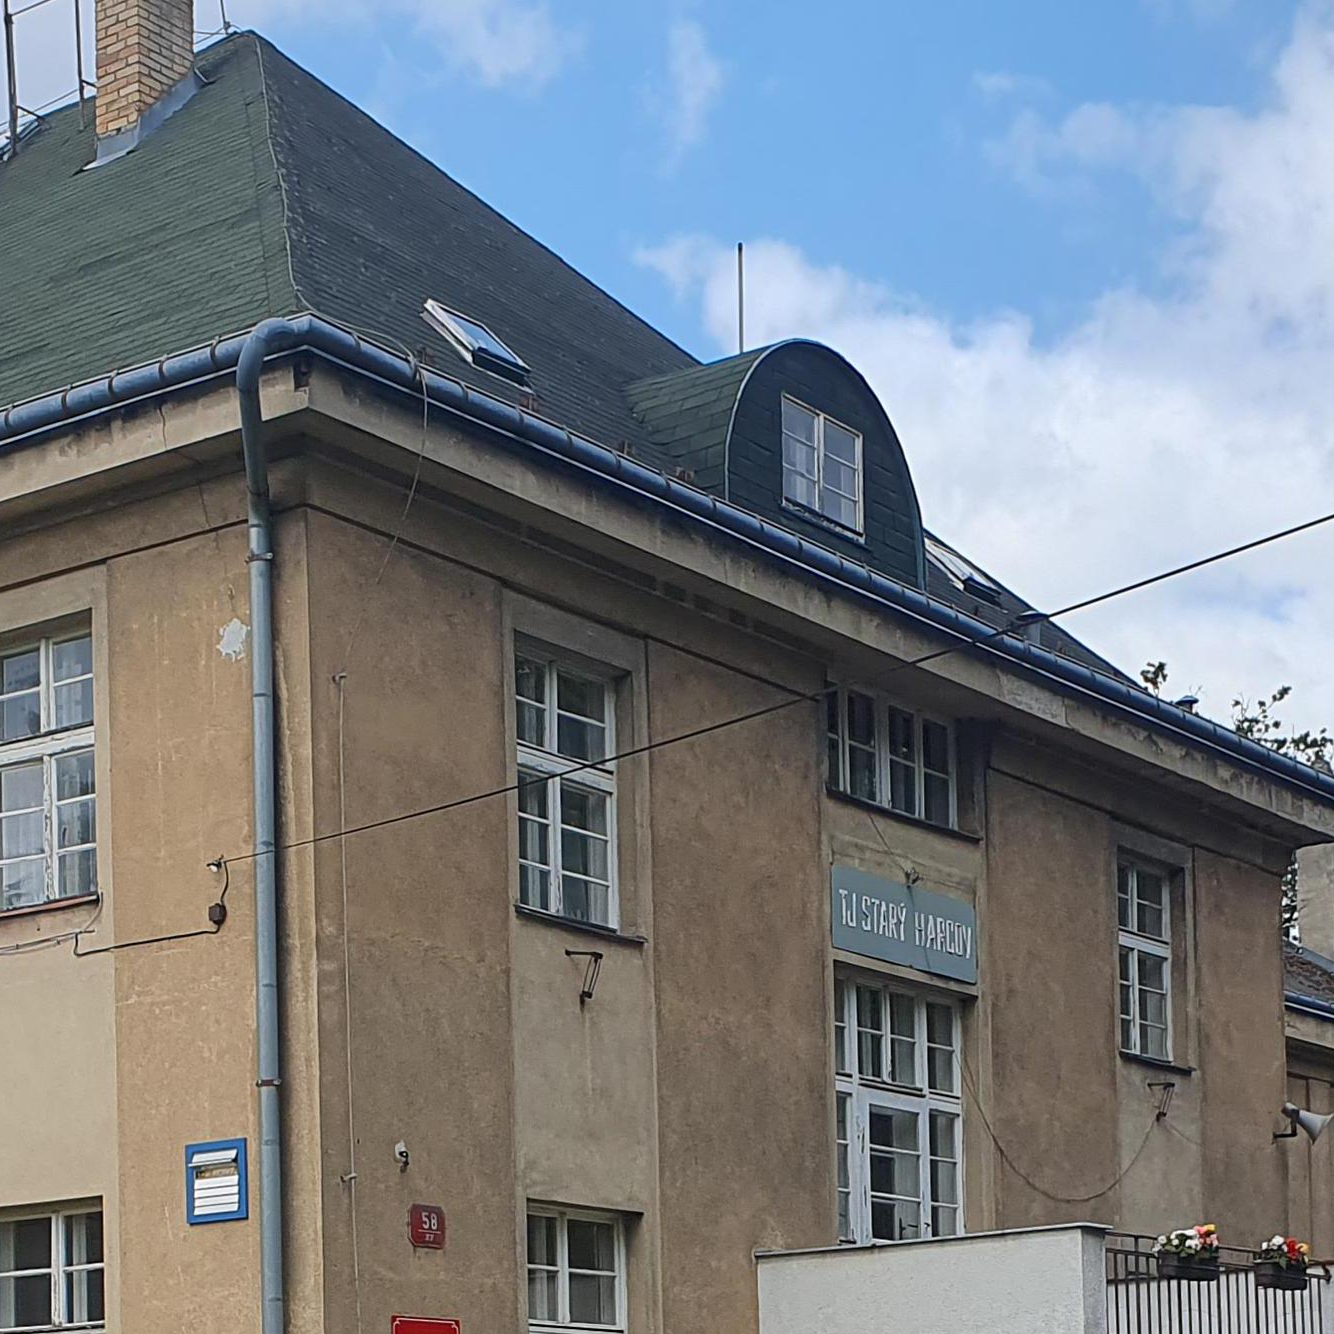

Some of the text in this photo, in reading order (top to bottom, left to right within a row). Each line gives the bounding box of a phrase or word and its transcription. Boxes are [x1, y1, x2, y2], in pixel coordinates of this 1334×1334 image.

[839, 889, 856, 927] TJ
[862, 895, 906, 941] STARÝ
[421, 1211, 438, 1230] 58
